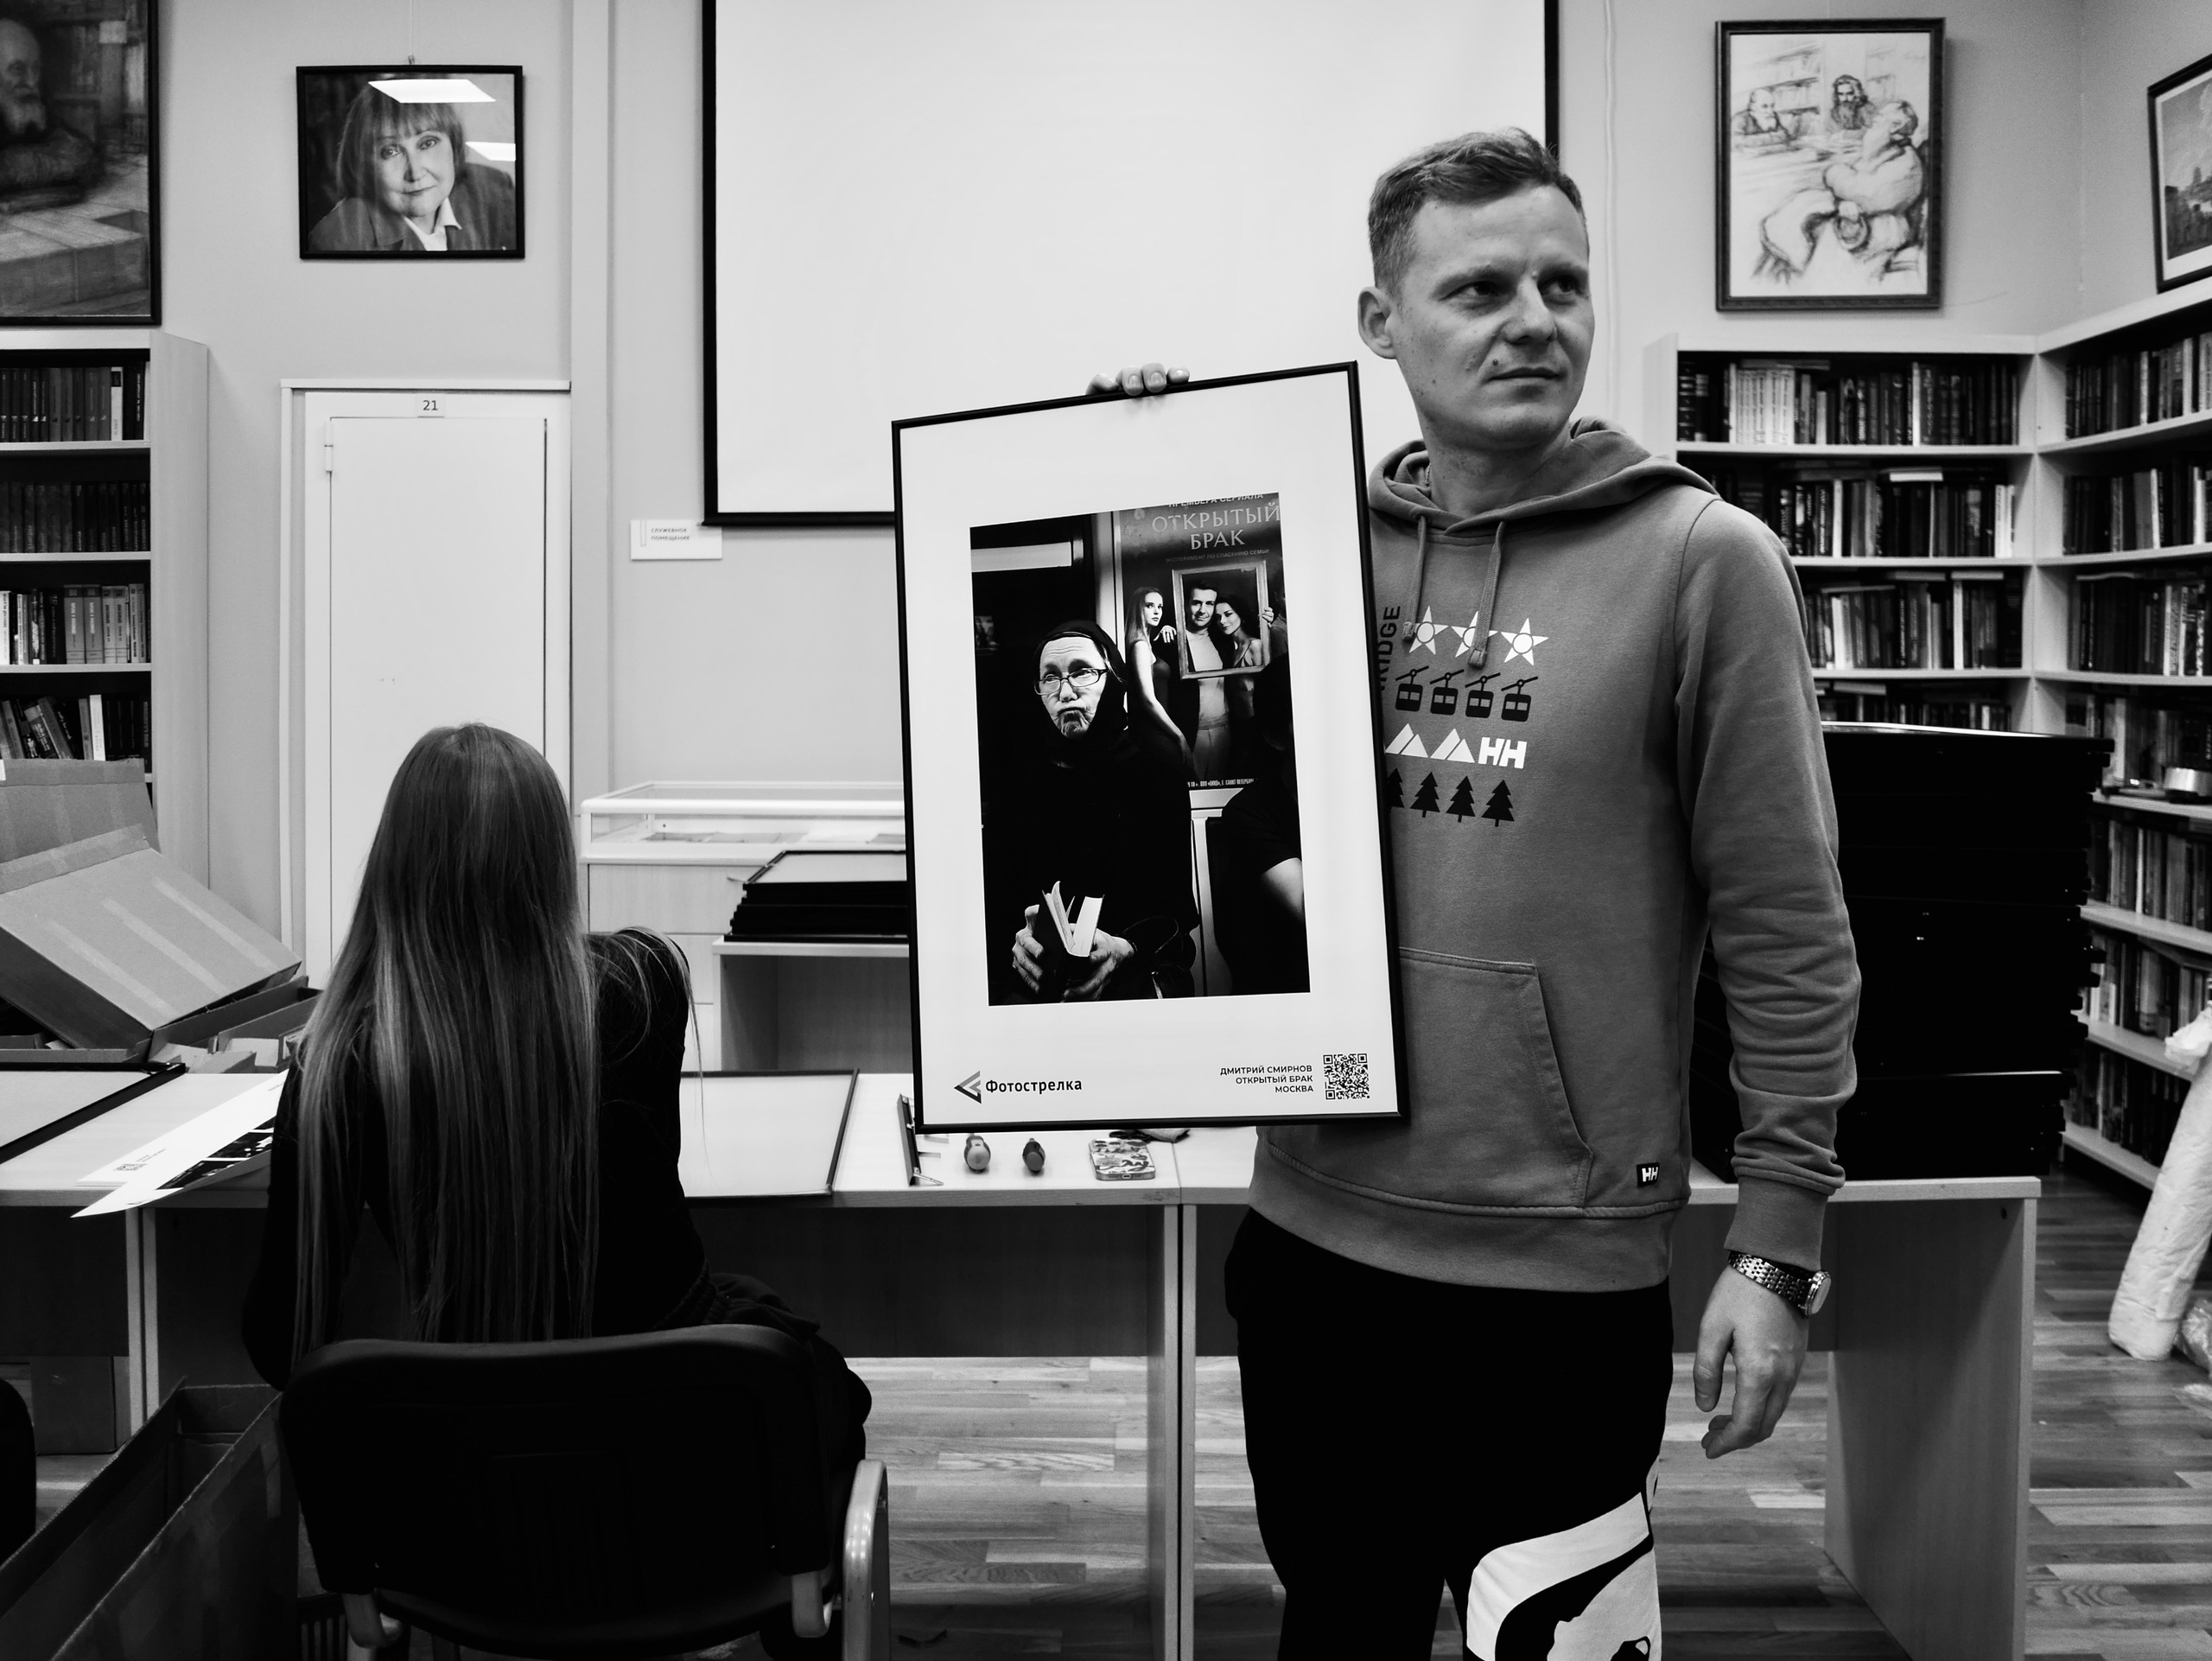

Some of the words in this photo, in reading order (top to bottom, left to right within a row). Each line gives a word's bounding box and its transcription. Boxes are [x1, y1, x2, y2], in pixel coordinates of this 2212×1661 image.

[423, 399, 439, 411] 21
[1152, 501, 1281, 532] ОТКРЫТЫЙ
[1190, 529, 1245, 550] БРАК
[1219, 1065, 1265, 1076] ДМИТРИЙ
[1267, 1065, 1313, 1073] СМИРНОВ
[985, 1079, 1083, 1095] Фотострелка
[1236, 1074, 1287, 1085] ОТКРЫТЫЙ
[1642, 1167, 1658, 1182] HH
